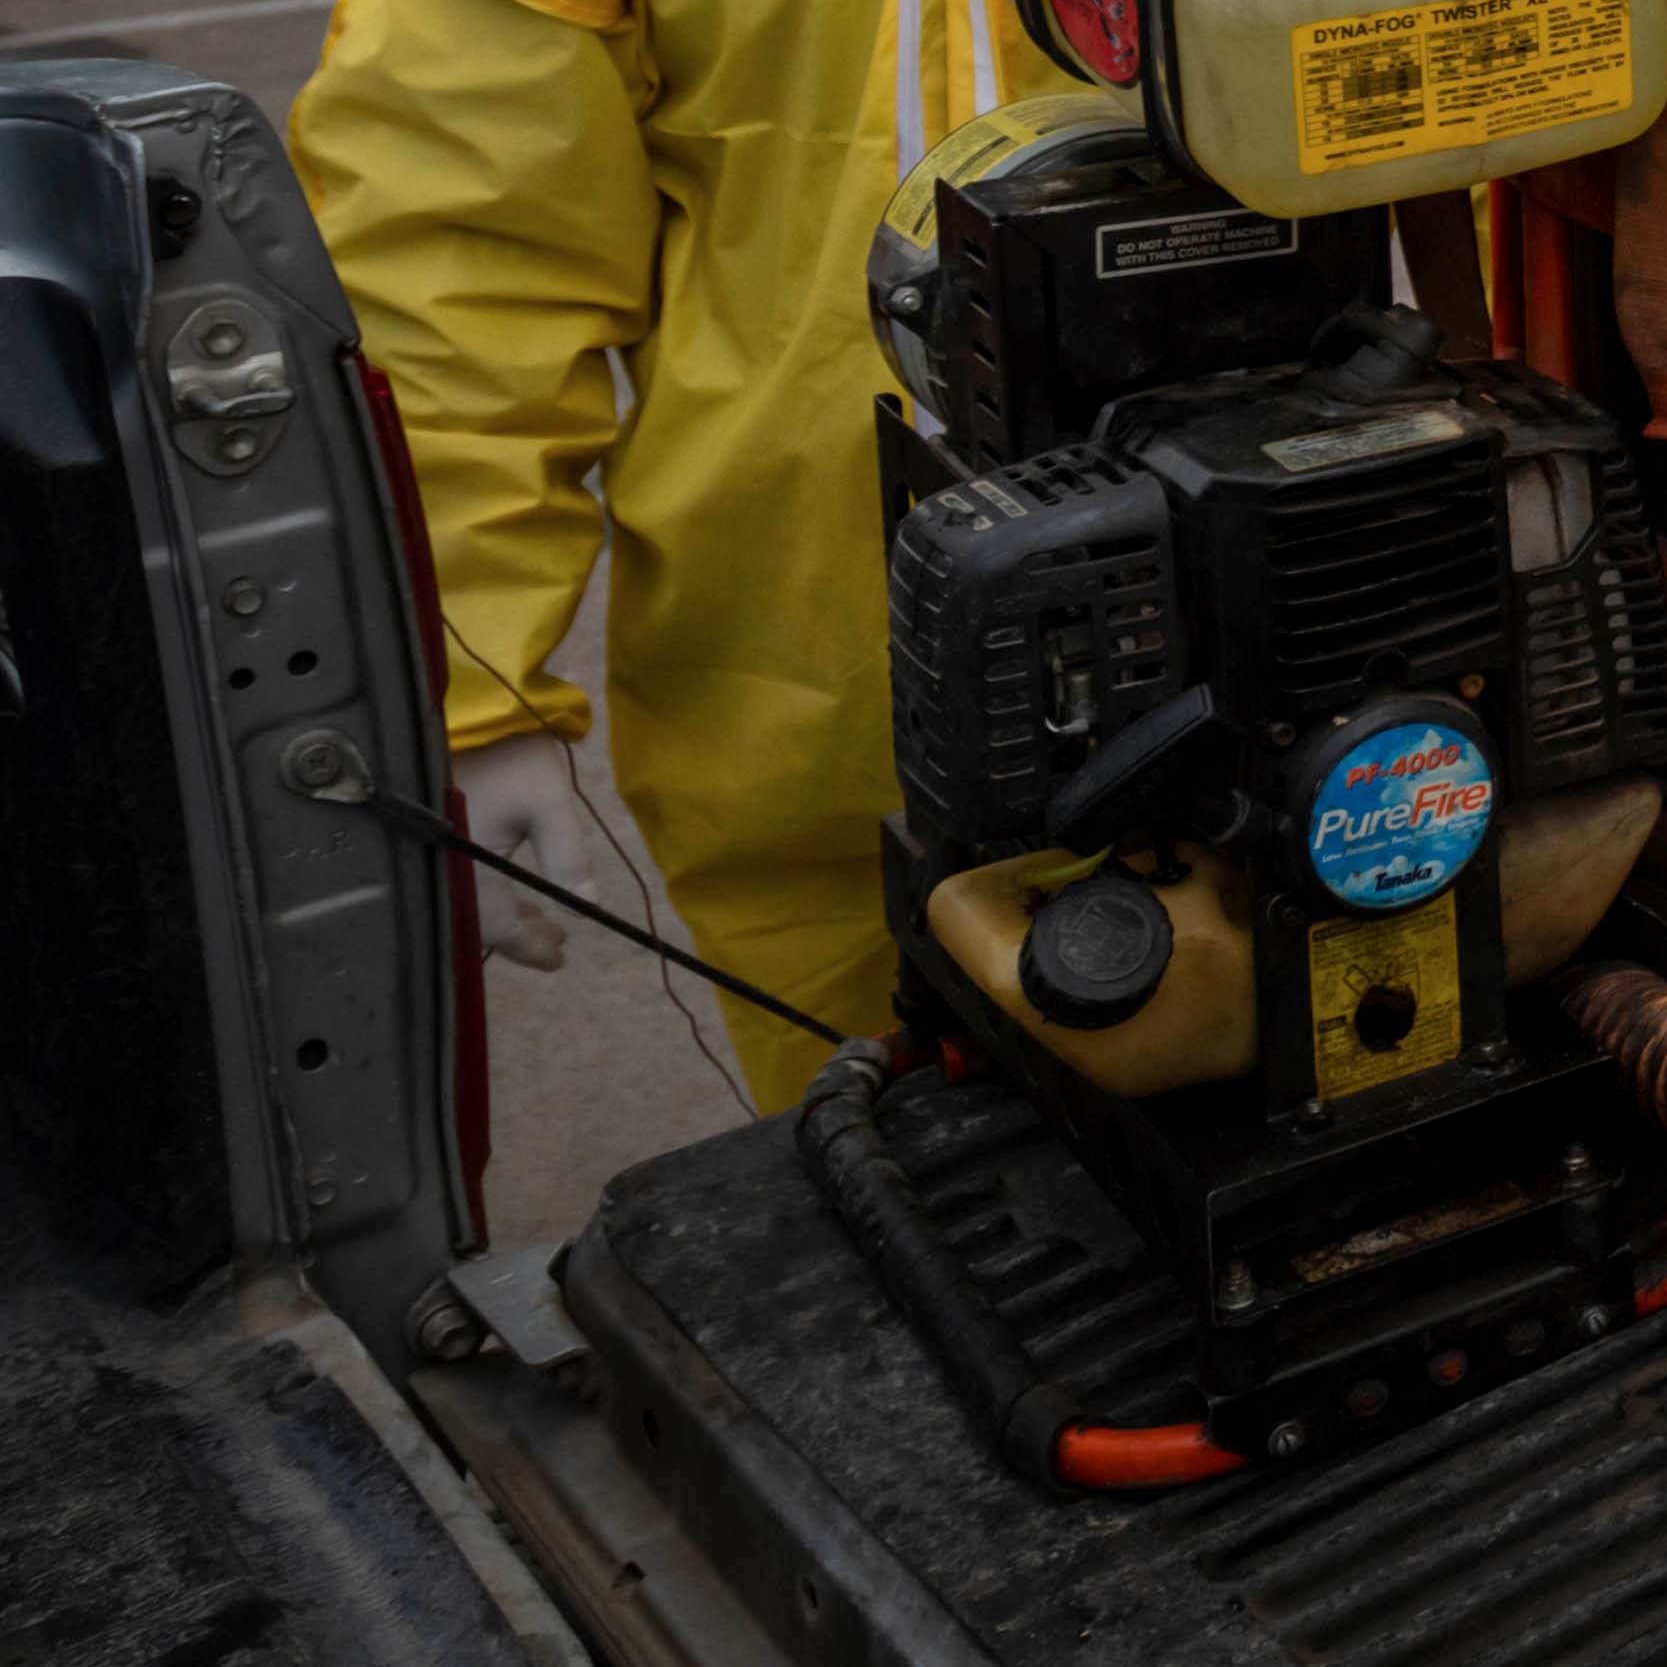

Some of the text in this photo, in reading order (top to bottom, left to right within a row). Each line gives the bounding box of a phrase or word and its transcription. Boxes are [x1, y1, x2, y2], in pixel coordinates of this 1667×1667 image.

[1117, 225, 1277, 255] DO NOT OPERATE MACHINE
[1170, 219, 1226, 235] WARNING
[1116, 236, 1281, 266] WITH THIS COVER REMOVED
[1346, 745, 1460, 790] PF-4000
[1313, 781, 1487, 850] PureFire
[1375, 863, 1433, 892] Tanaka
